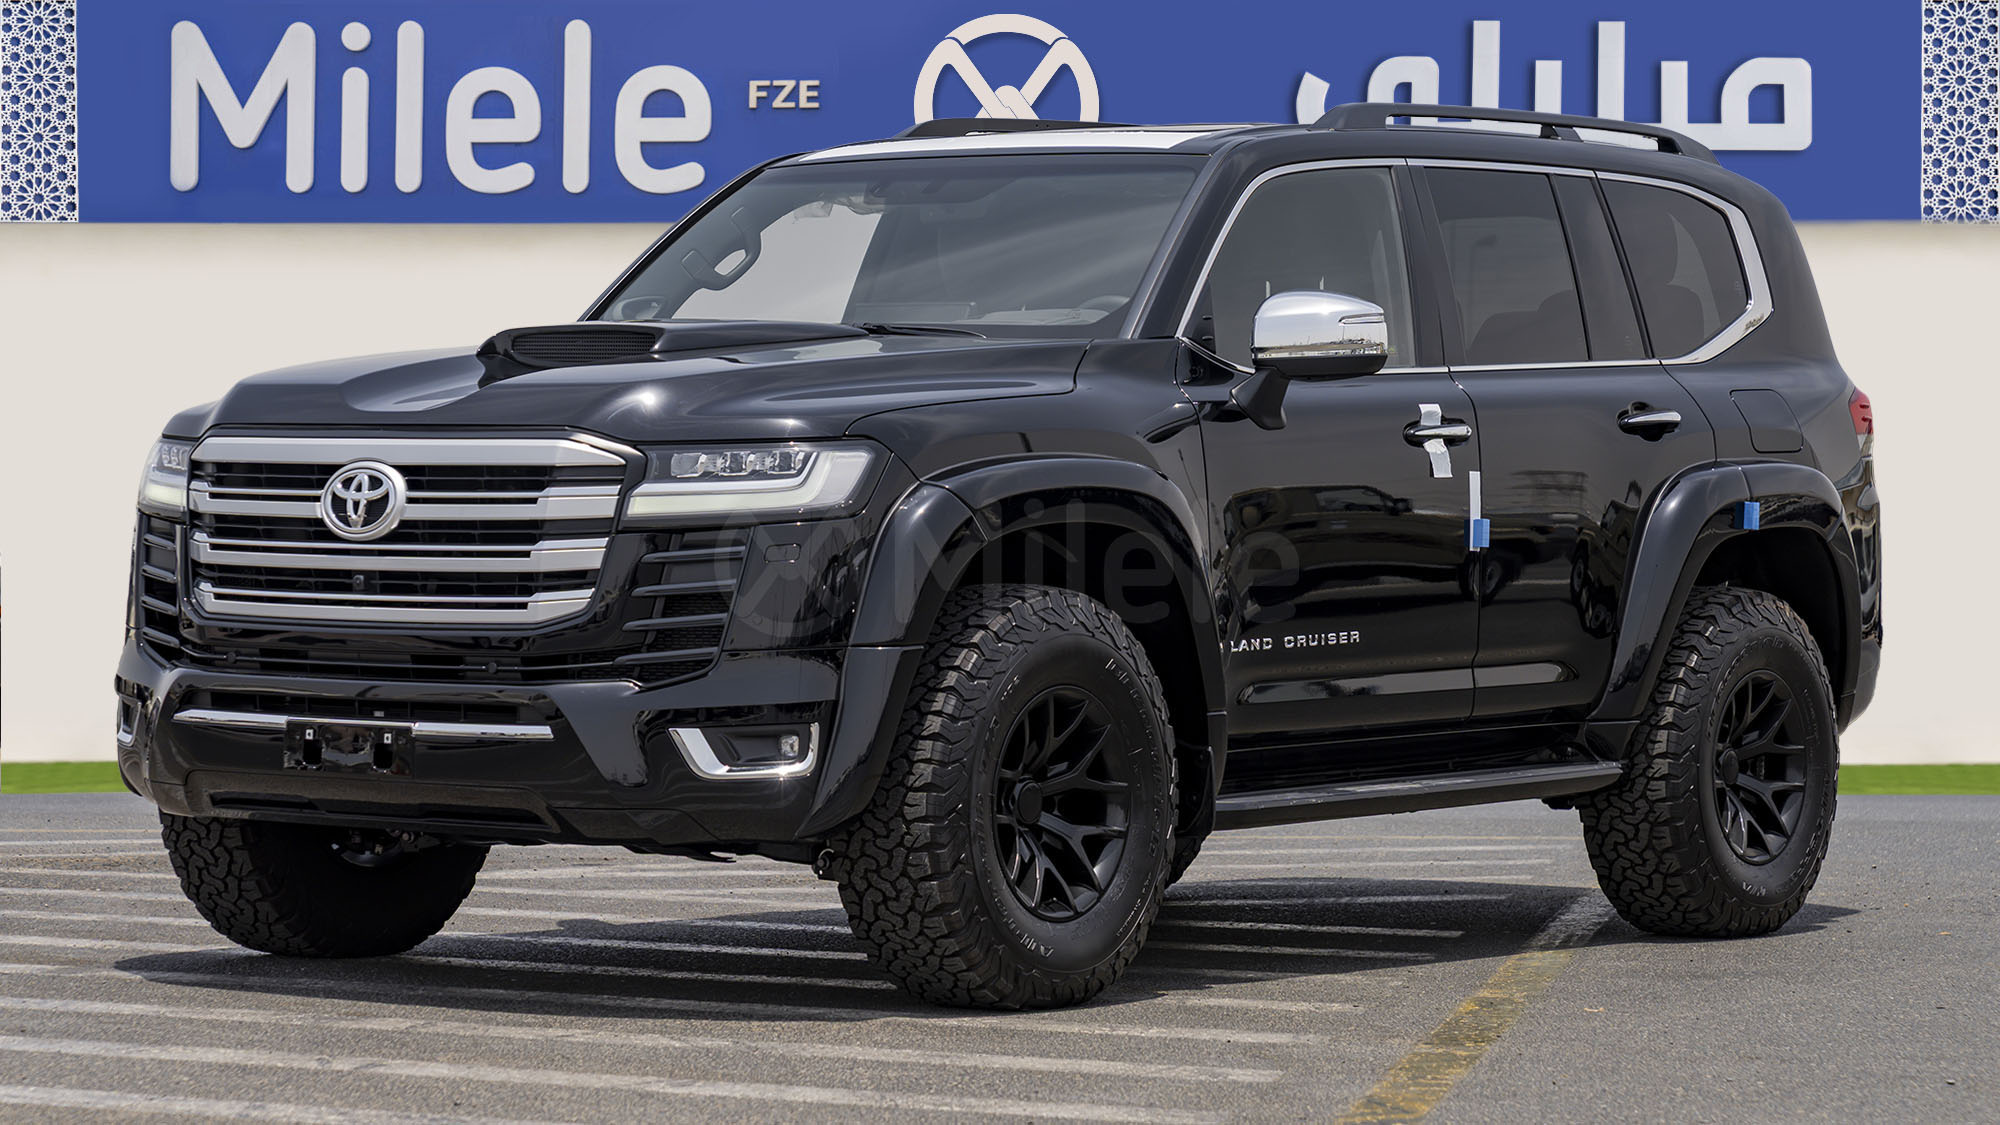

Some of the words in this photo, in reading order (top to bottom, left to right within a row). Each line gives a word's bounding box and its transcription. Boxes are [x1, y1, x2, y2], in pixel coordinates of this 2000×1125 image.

[170, 19, 712, 195] Milele
[747, 79, 821, 110] FZE
[1230, 636, 1274, 654] LAND
[1284, 629, 1362, 650] CRUISER
